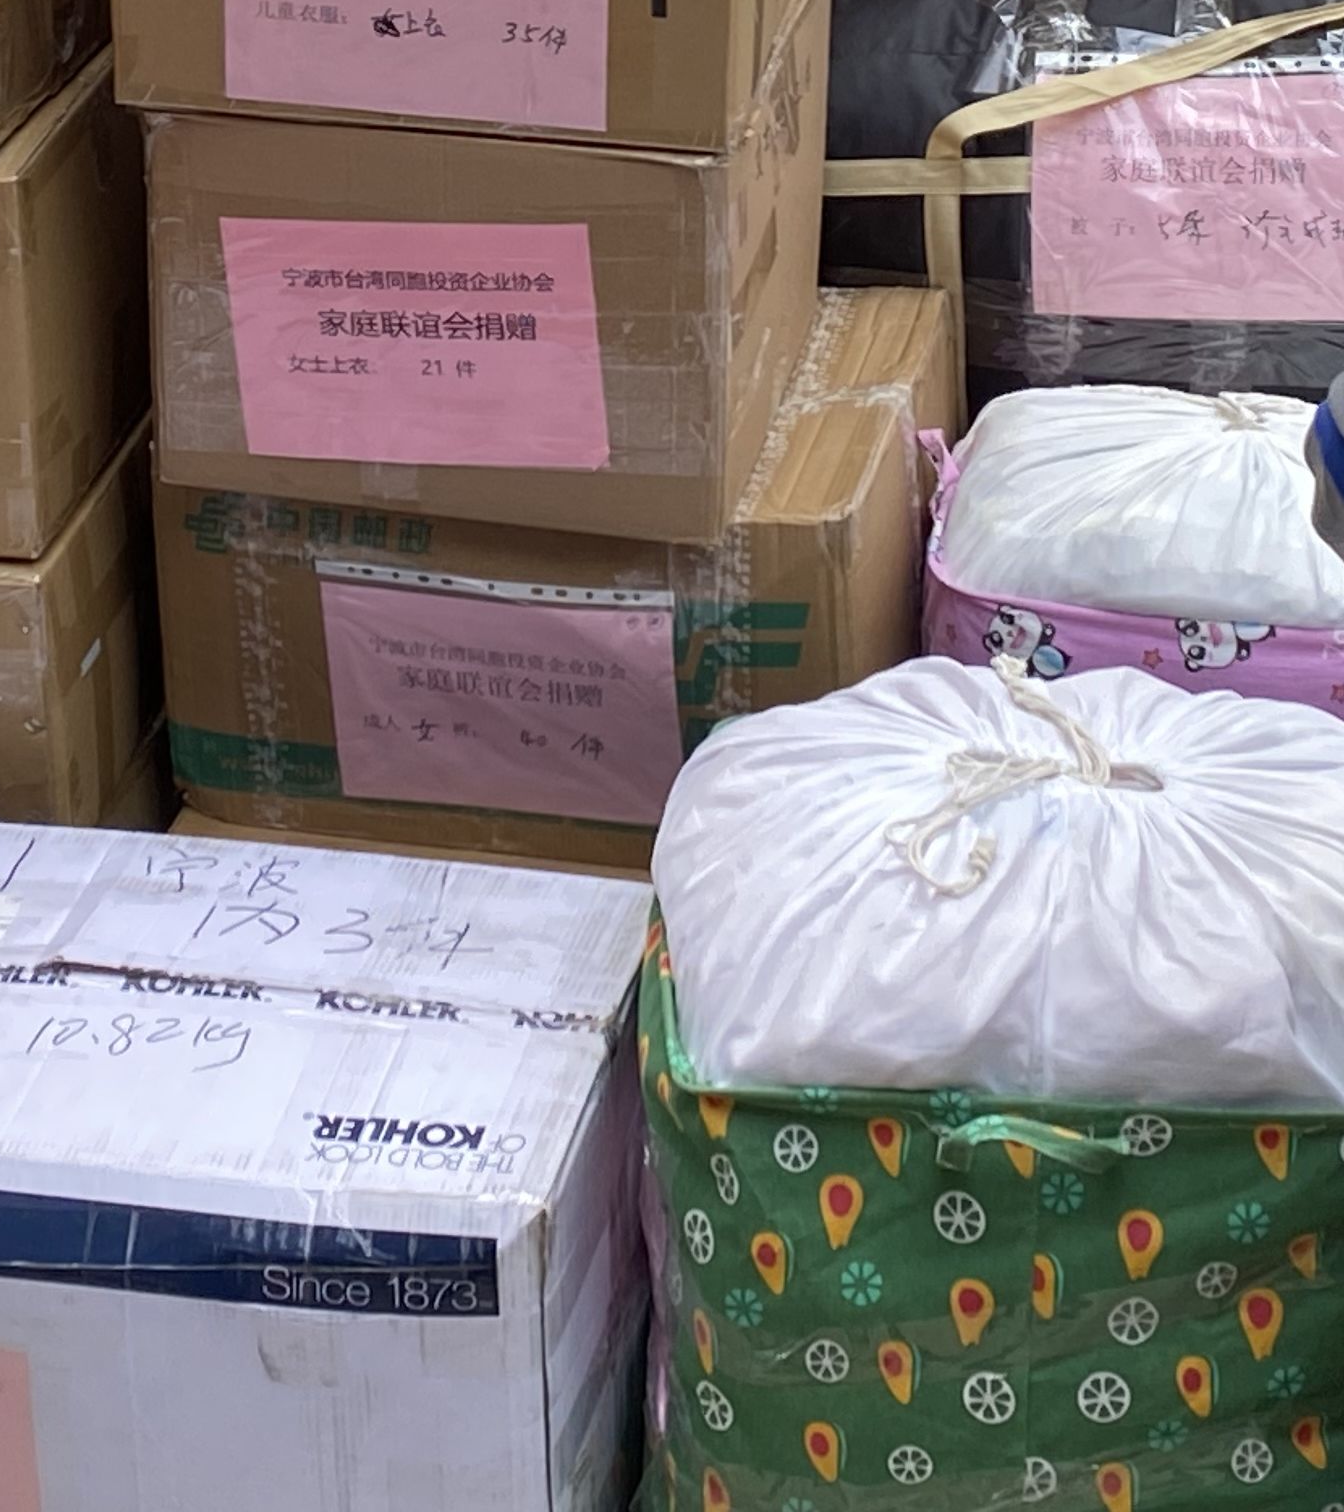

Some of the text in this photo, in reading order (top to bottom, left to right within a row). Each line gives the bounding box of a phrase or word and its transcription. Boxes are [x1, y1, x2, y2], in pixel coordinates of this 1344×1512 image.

[282, 268, 554, 293] 宁波市台湾同胞投资企业协会
[318, 308, 537, 341] 家庭联谊会捐赠
[368, 635, 626, 680] 宁波市台湾同胞投资企业协会
[396, 665, 604, 708] 家庭联谊会捐赠
[121, 965, 263, 1003] KOHLER
[315, 989, 462, 1023] KOHLER
[312, 1113, 487, 1151] KOHLER
[262, 1264, 478, 1313] Since 1873
